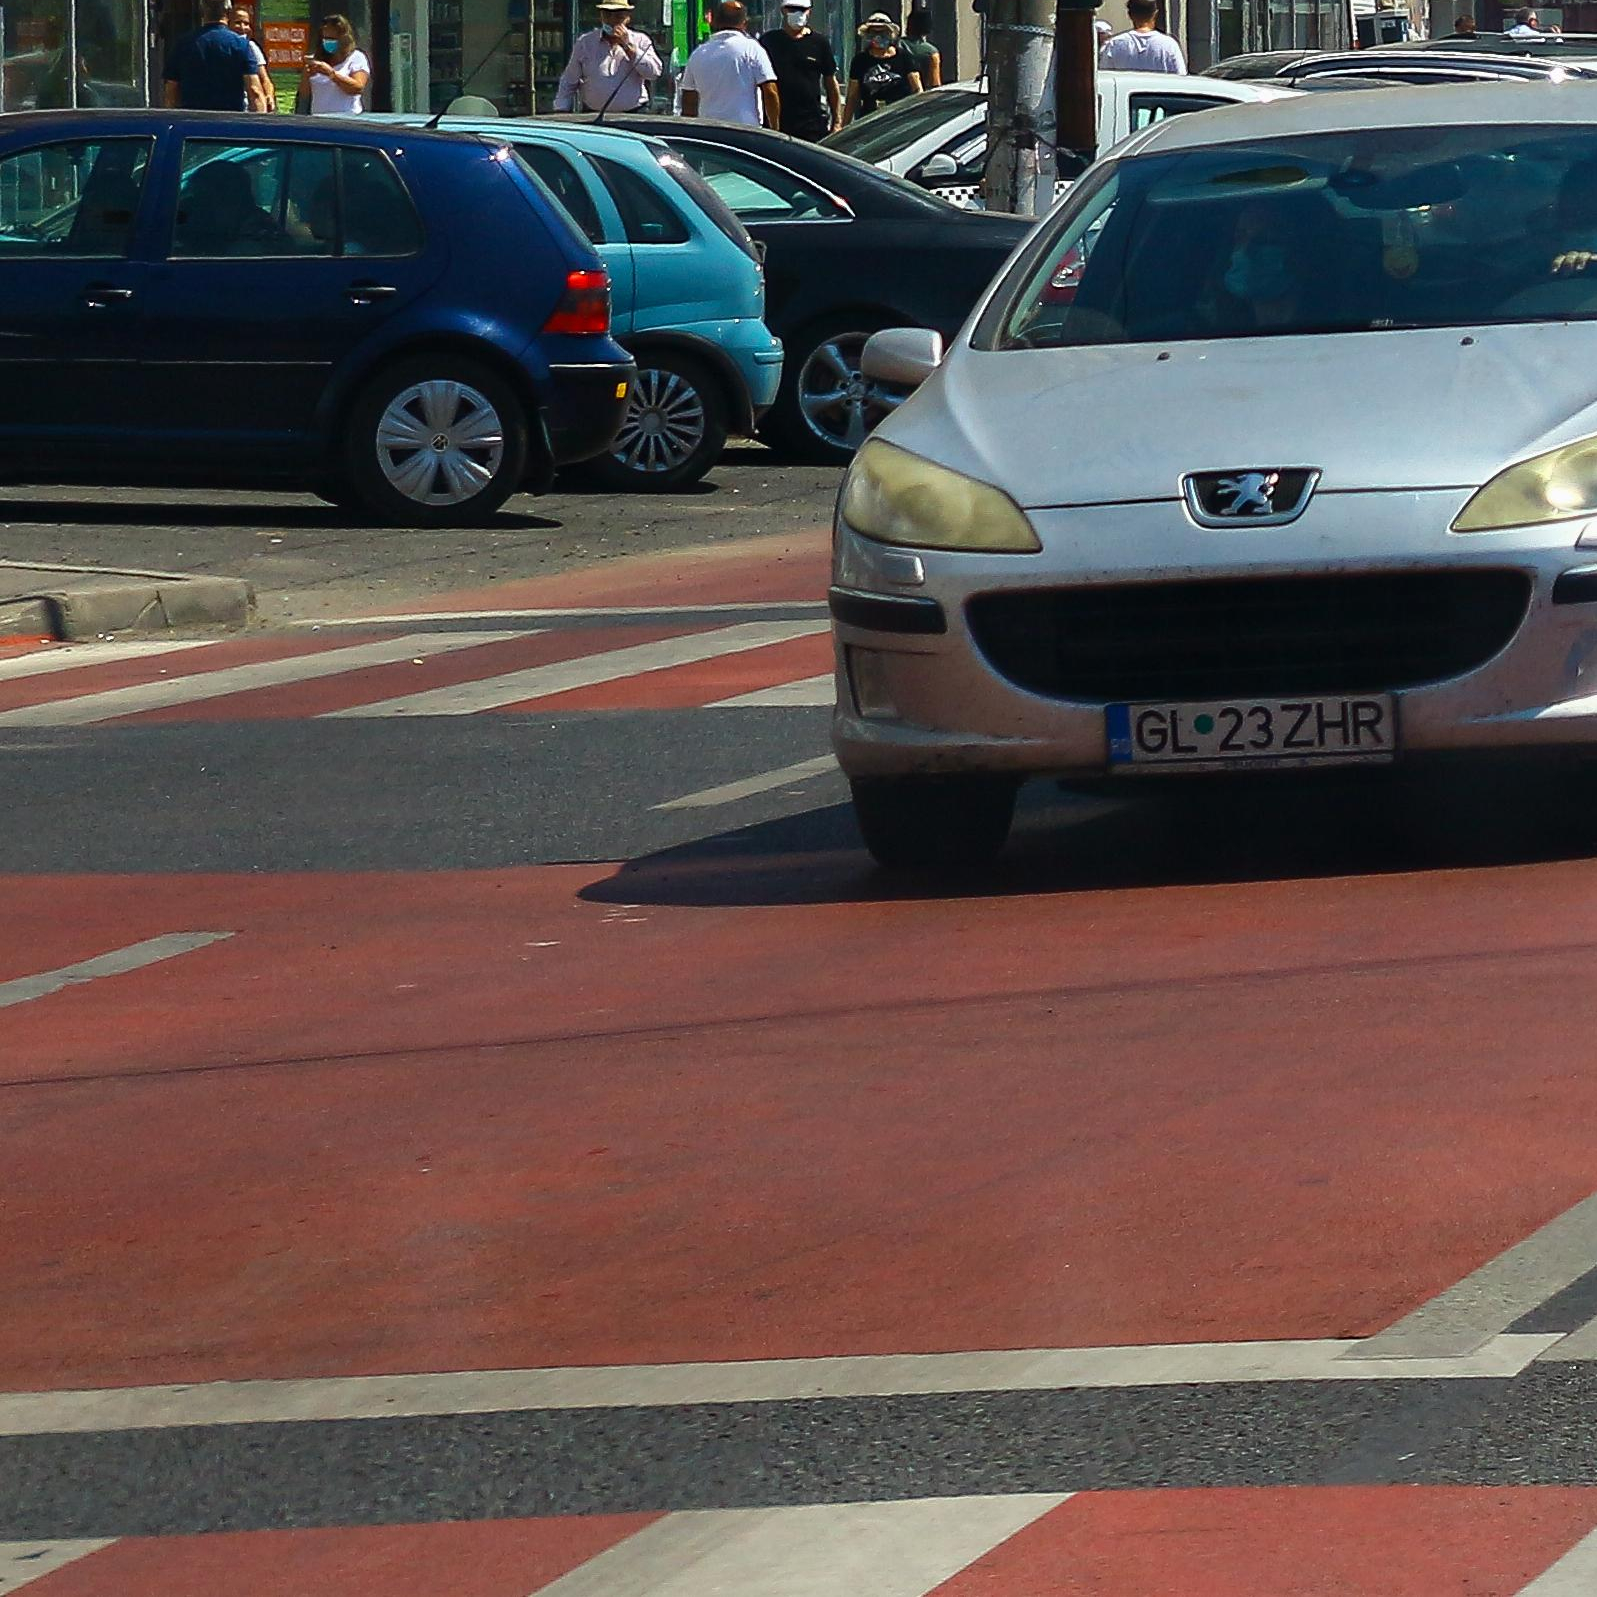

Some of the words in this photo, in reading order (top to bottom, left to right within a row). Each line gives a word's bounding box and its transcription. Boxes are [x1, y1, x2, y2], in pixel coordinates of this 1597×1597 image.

[1135, 710, 1198, 753] GL
[1218, 706, 1274, 752] 23
[1279, 700, 1385, 748] ZHR
